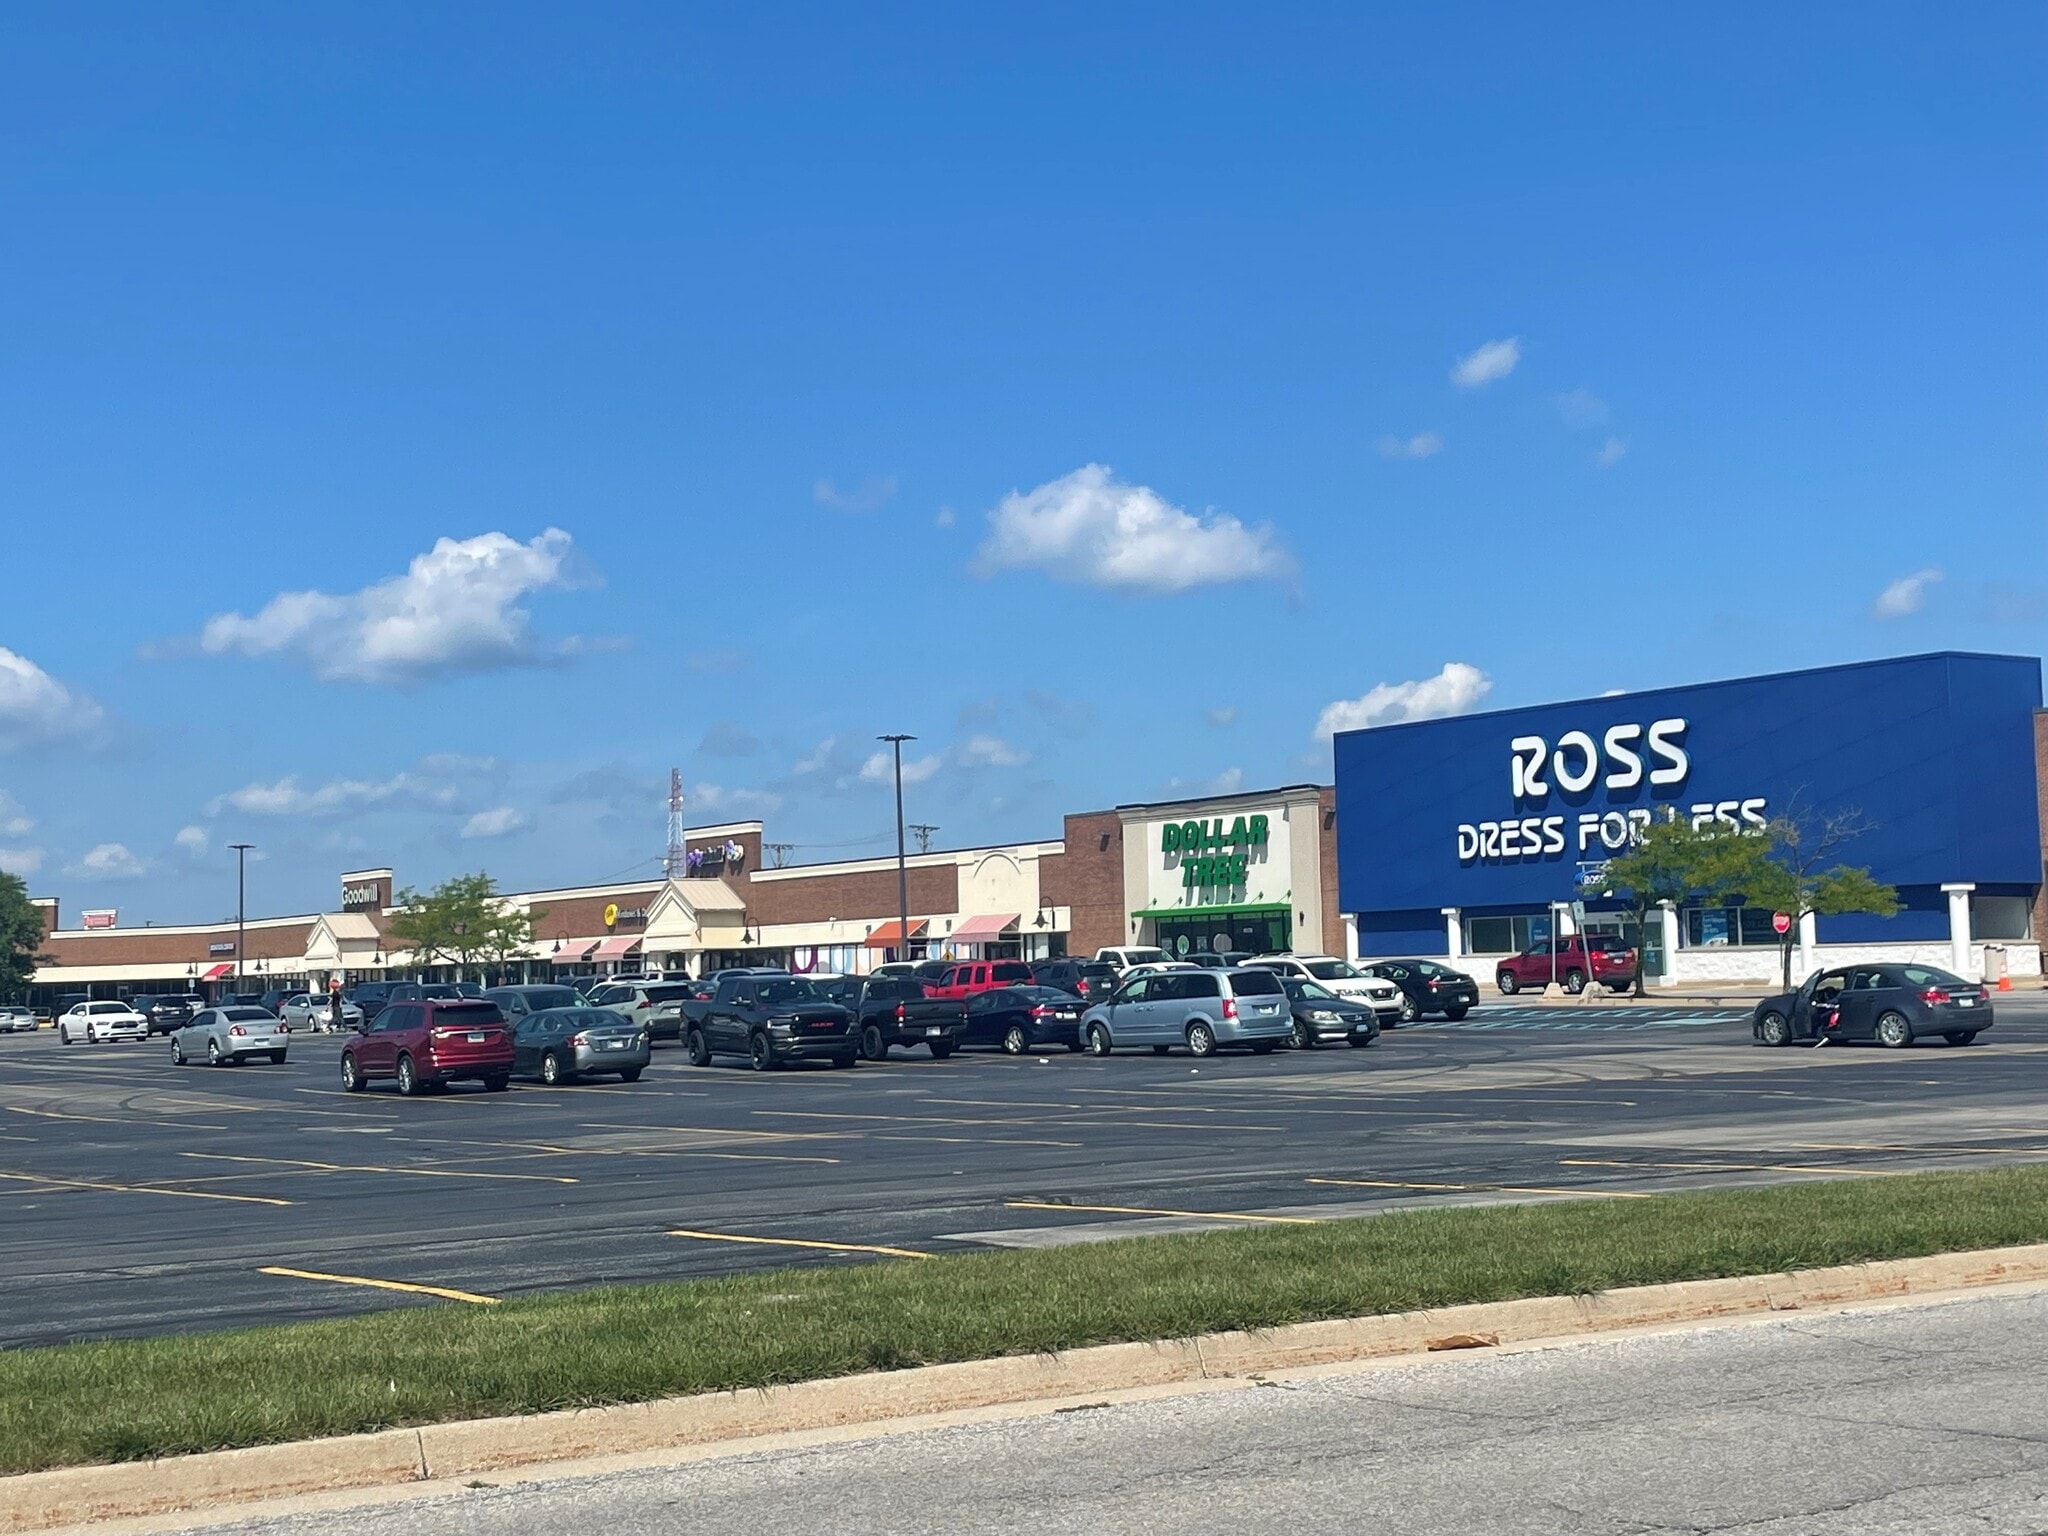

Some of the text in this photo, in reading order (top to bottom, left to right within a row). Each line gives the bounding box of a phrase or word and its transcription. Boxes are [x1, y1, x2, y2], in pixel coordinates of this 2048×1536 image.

[1511, 717, 1688, 797] ROSS
[1162, 814, 1268, 852] DOLLAR
[1458, 815, 1565, 859] DRESS
[1578, 808, 1653, 850] FOR
[1181, 853, 1248, 887] TREE
[1583, 874, 1605, 885] ROSS
[341, 883, 378, 905] Goodwill
